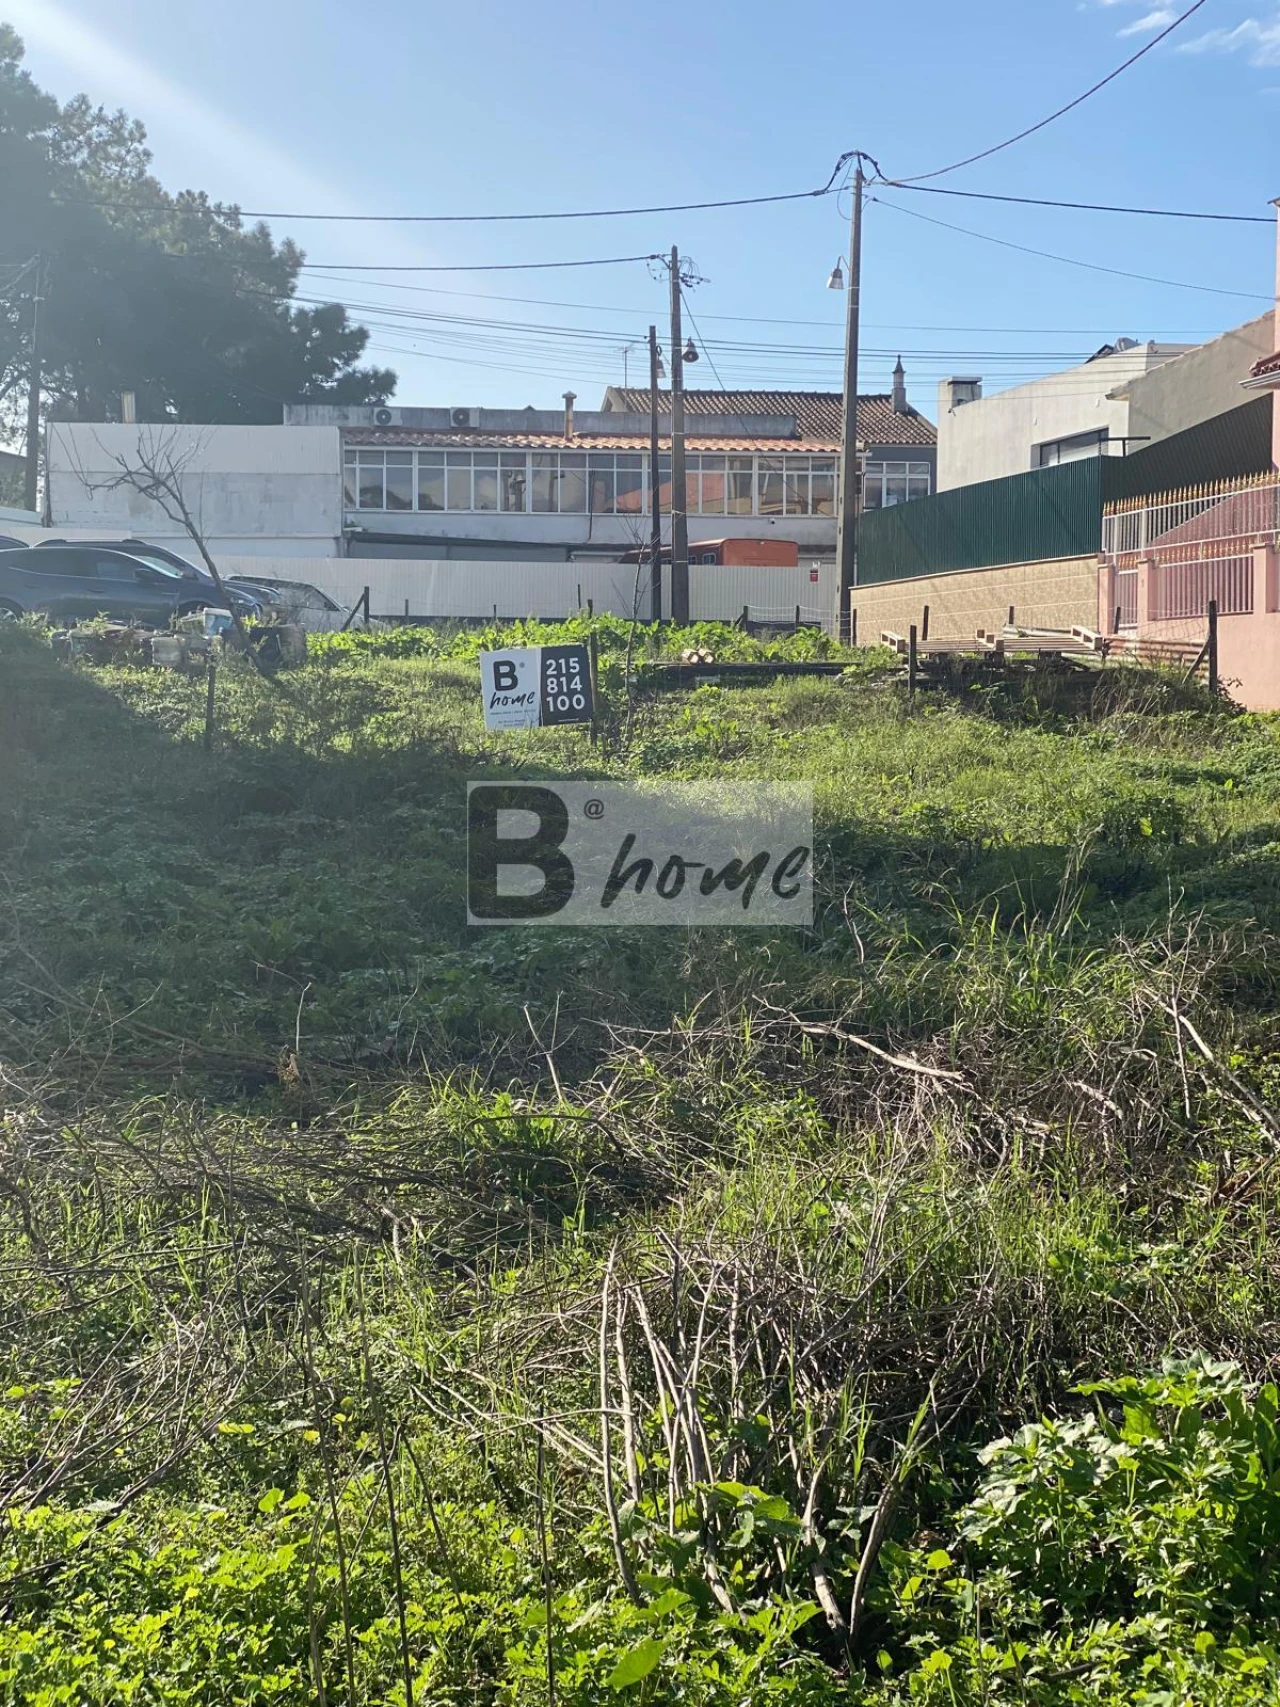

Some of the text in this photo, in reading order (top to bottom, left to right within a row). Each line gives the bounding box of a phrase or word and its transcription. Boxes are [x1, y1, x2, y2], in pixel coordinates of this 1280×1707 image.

[493, 660, 518, 691] B
[546, 658, 580, 675] 215
[547, 675, 583, 694] 814
[490, 691, 535, 709] home
[546, 694, 585, 712] 100
